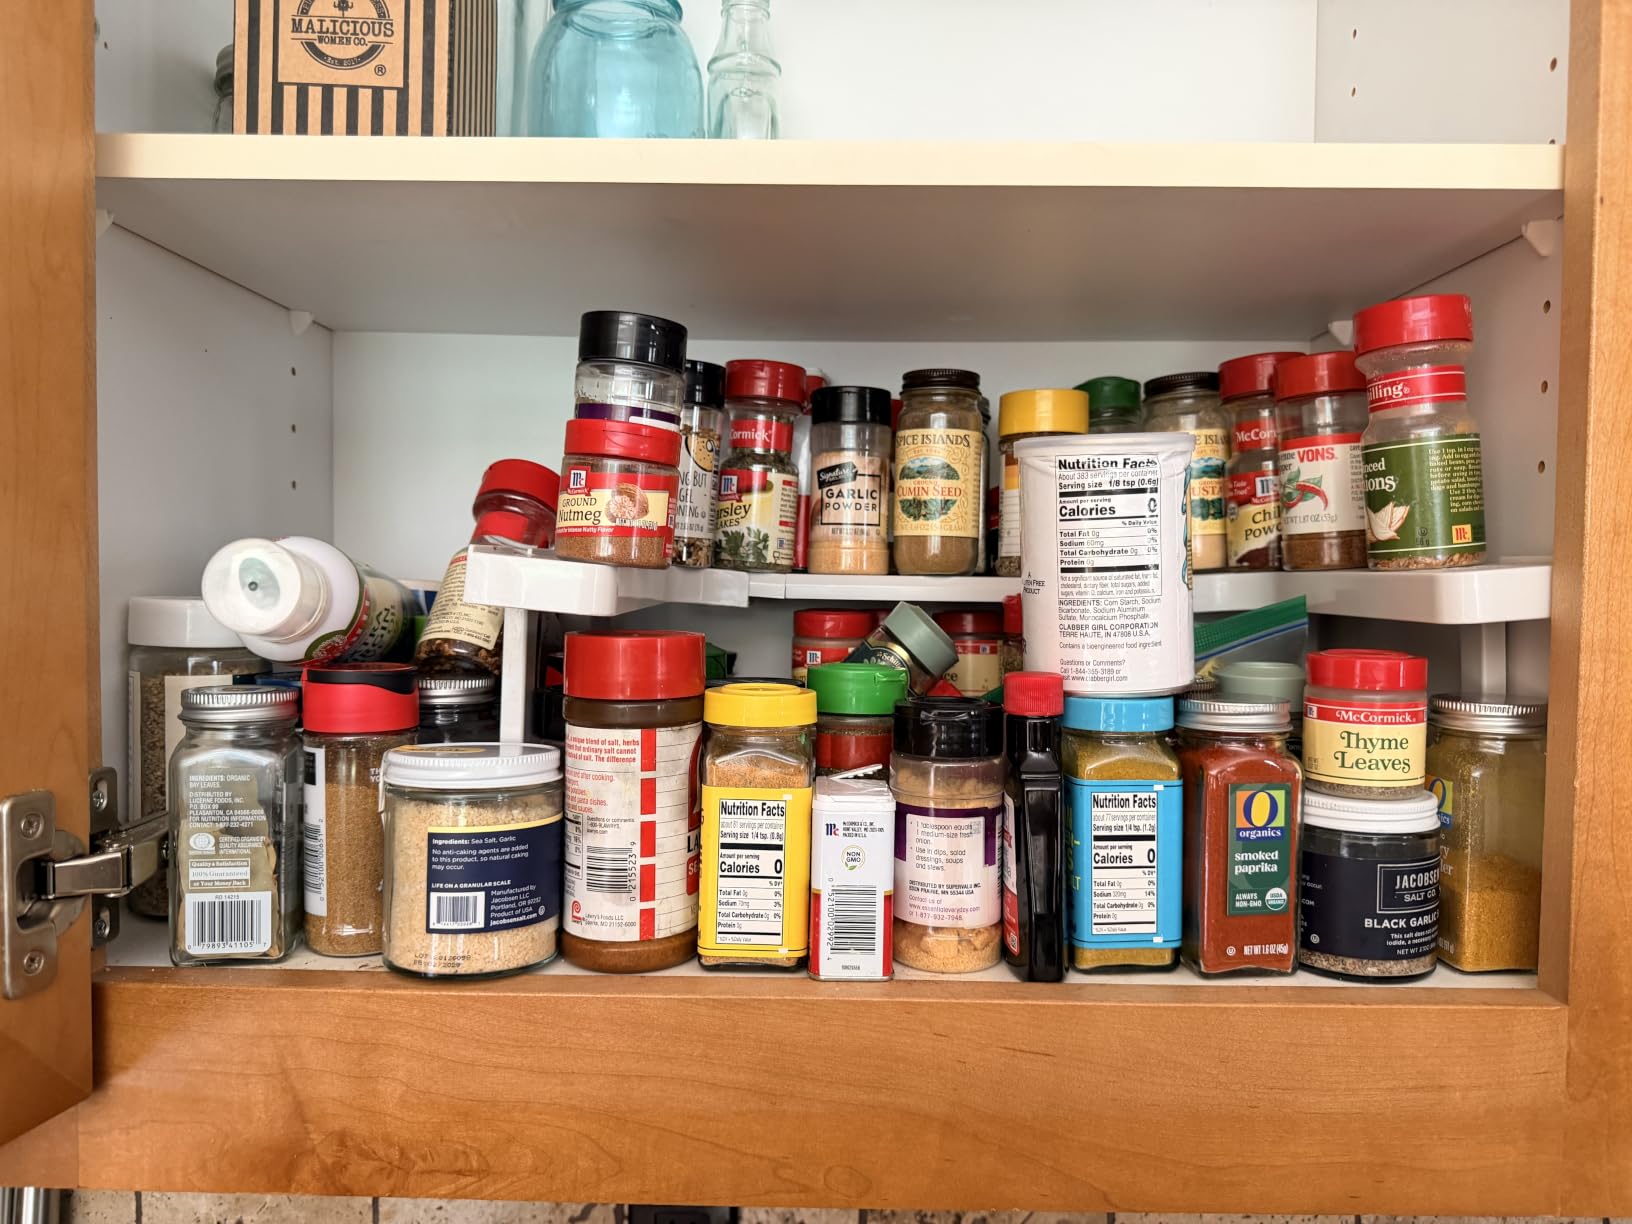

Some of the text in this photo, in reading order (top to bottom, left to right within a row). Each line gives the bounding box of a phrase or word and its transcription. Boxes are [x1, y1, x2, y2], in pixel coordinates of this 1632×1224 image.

[291, 18, 394, 37] MALICIOUS
[317, 36, 368, 46] WOMEN CO.
[344, 58, 358, 66] 2017
[921, 434, 970, 447] ISLANDS
[1297, 448, 1335, 463] VONS
[1059, 458, 1118, 470] Nutrition
[693, 471, 707, 487] BUT
[897, 486, 961, 497] CUMIN SEED
[1059, 482, 1085, 490] Serving
[826, 489, 877, 499] GARLIC
[562, 498, 597, 507] GROUND
[825, 503, 876, 511] POWDER
[1059, 498, 1157, 517] Calories 0
[559, 509, 601, 525] Nutmeg
[1092, 530, 1100, 538] 0g
[1087, 540, 1104, 548] 60mg
[1336, 710, 1412, 722] McCormick
[1340, 731, 1409, 753] Thyme
[1334, 751, 1411, 773] Leaves
[1093, 794, 1156, 808] Nutrition Facts
[721, 801, 784, 817] Nutrition Facts
[721, 831, 738, 840] Serving
[760, 832, 768, 840] tsp.
[1239, 829, 1281, 839] organics
[511, 844, 528, 852] added
[1094, 848, 1155, 863] Calories 0
[1235, 850, 1279, 861] smoked
[720, 859, 782, 874] Calories 0
[1235, 862, 1278, 875] paprika
[491, 887, 529, 896] Manufactured
[1404, 889, 1436, 902] SALT CO.
[491, 895, 518, 903] Jacobsen
[490, 913, 537, 926] jacobsensalt.com
[491, 910, 514, 918] Product
[1365, 912, 1436, 928] BLACK GARLIC
[1244, 945, 1252, 955] NET
[1254, 945, 1261, 955] WT
[1270, 944, 1276, 954] OZ
